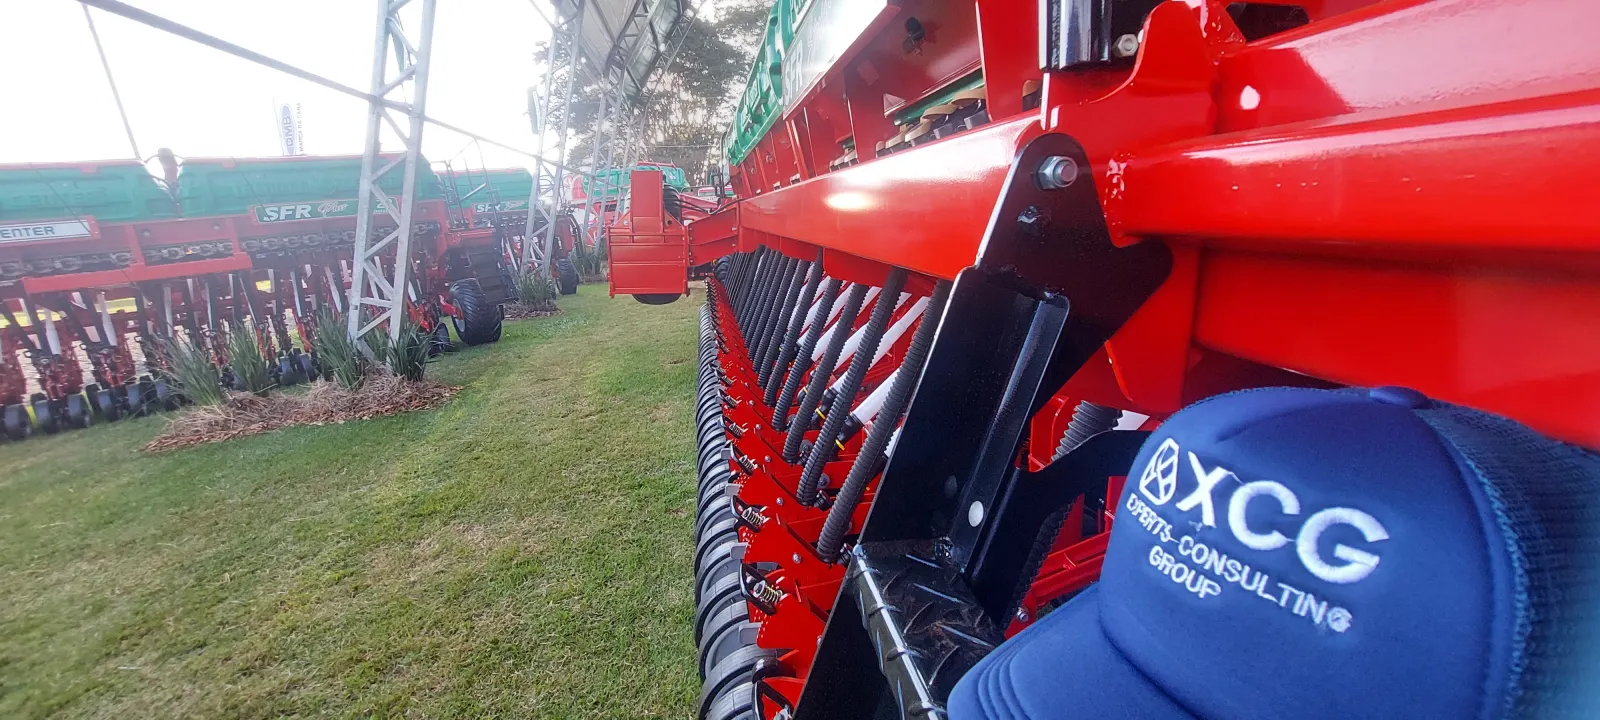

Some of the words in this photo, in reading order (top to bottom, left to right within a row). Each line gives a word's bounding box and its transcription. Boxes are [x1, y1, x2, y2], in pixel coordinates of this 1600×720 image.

[283, 115, 293, 147] DMB
[0, 226, 56, 238] ENTER
[263, 204, 312, 222] SFR
[1175, 450, 1390, 584] XCG
[1126, 493, 1173, 542] EXPERTS
[1178, 535, 1353, 633] CONSULTING
[1149, 545, 1222, 599] GROUP
